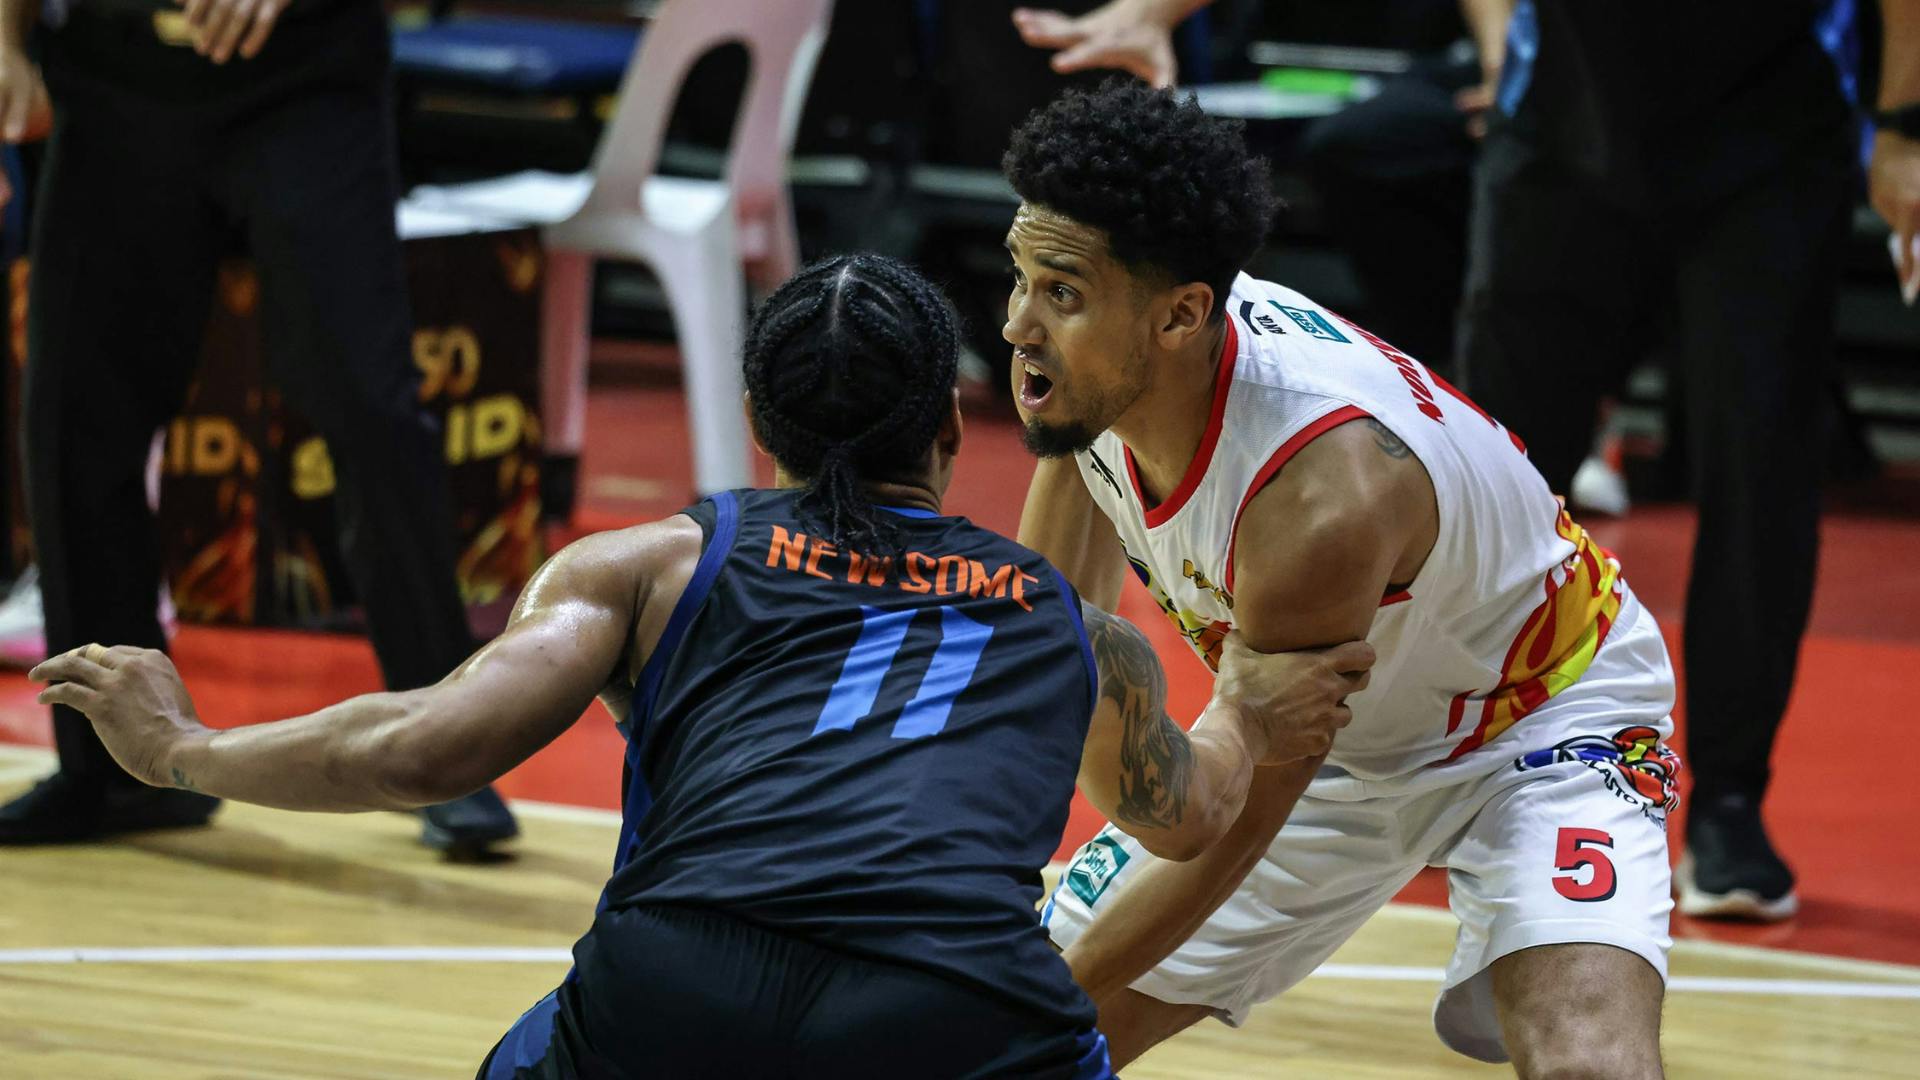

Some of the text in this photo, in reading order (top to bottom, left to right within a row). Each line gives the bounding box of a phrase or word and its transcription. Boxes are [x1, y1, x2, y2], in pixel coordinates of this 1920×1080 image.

[766, 524, 1039, 612] NEWSOME
[810, 605, 994, 740] 11
[1551, 827, 1617, 903] 5
